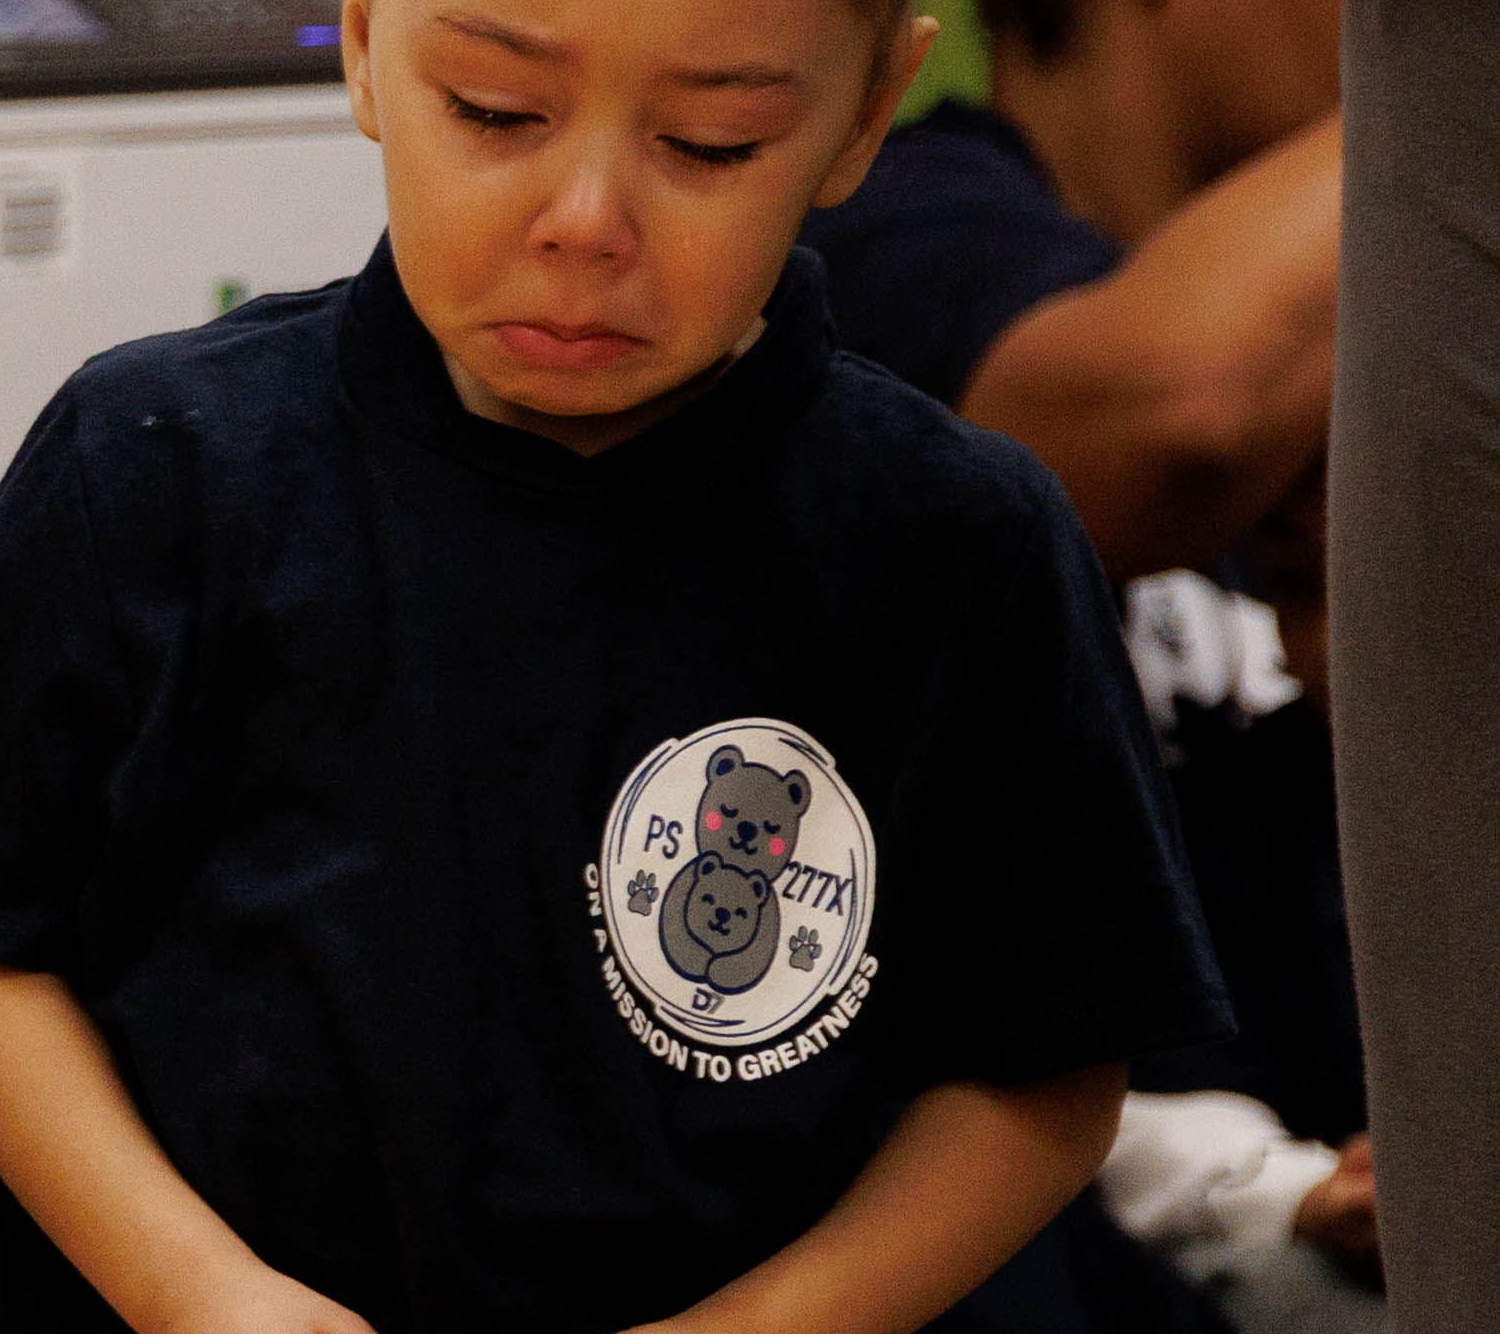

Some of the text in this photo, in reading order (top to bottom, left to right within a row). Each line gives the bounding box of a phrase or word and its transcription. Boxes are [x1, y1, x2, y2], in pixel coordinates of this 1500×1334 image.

[644, 813, 684, 860] PS
[781, 860, 854, 917] 277X
[600, 957, 689, 1072] MISSION
[691, 1050, 733, 1083] TO
[737, 952, 880, 1082] GREATNESS
